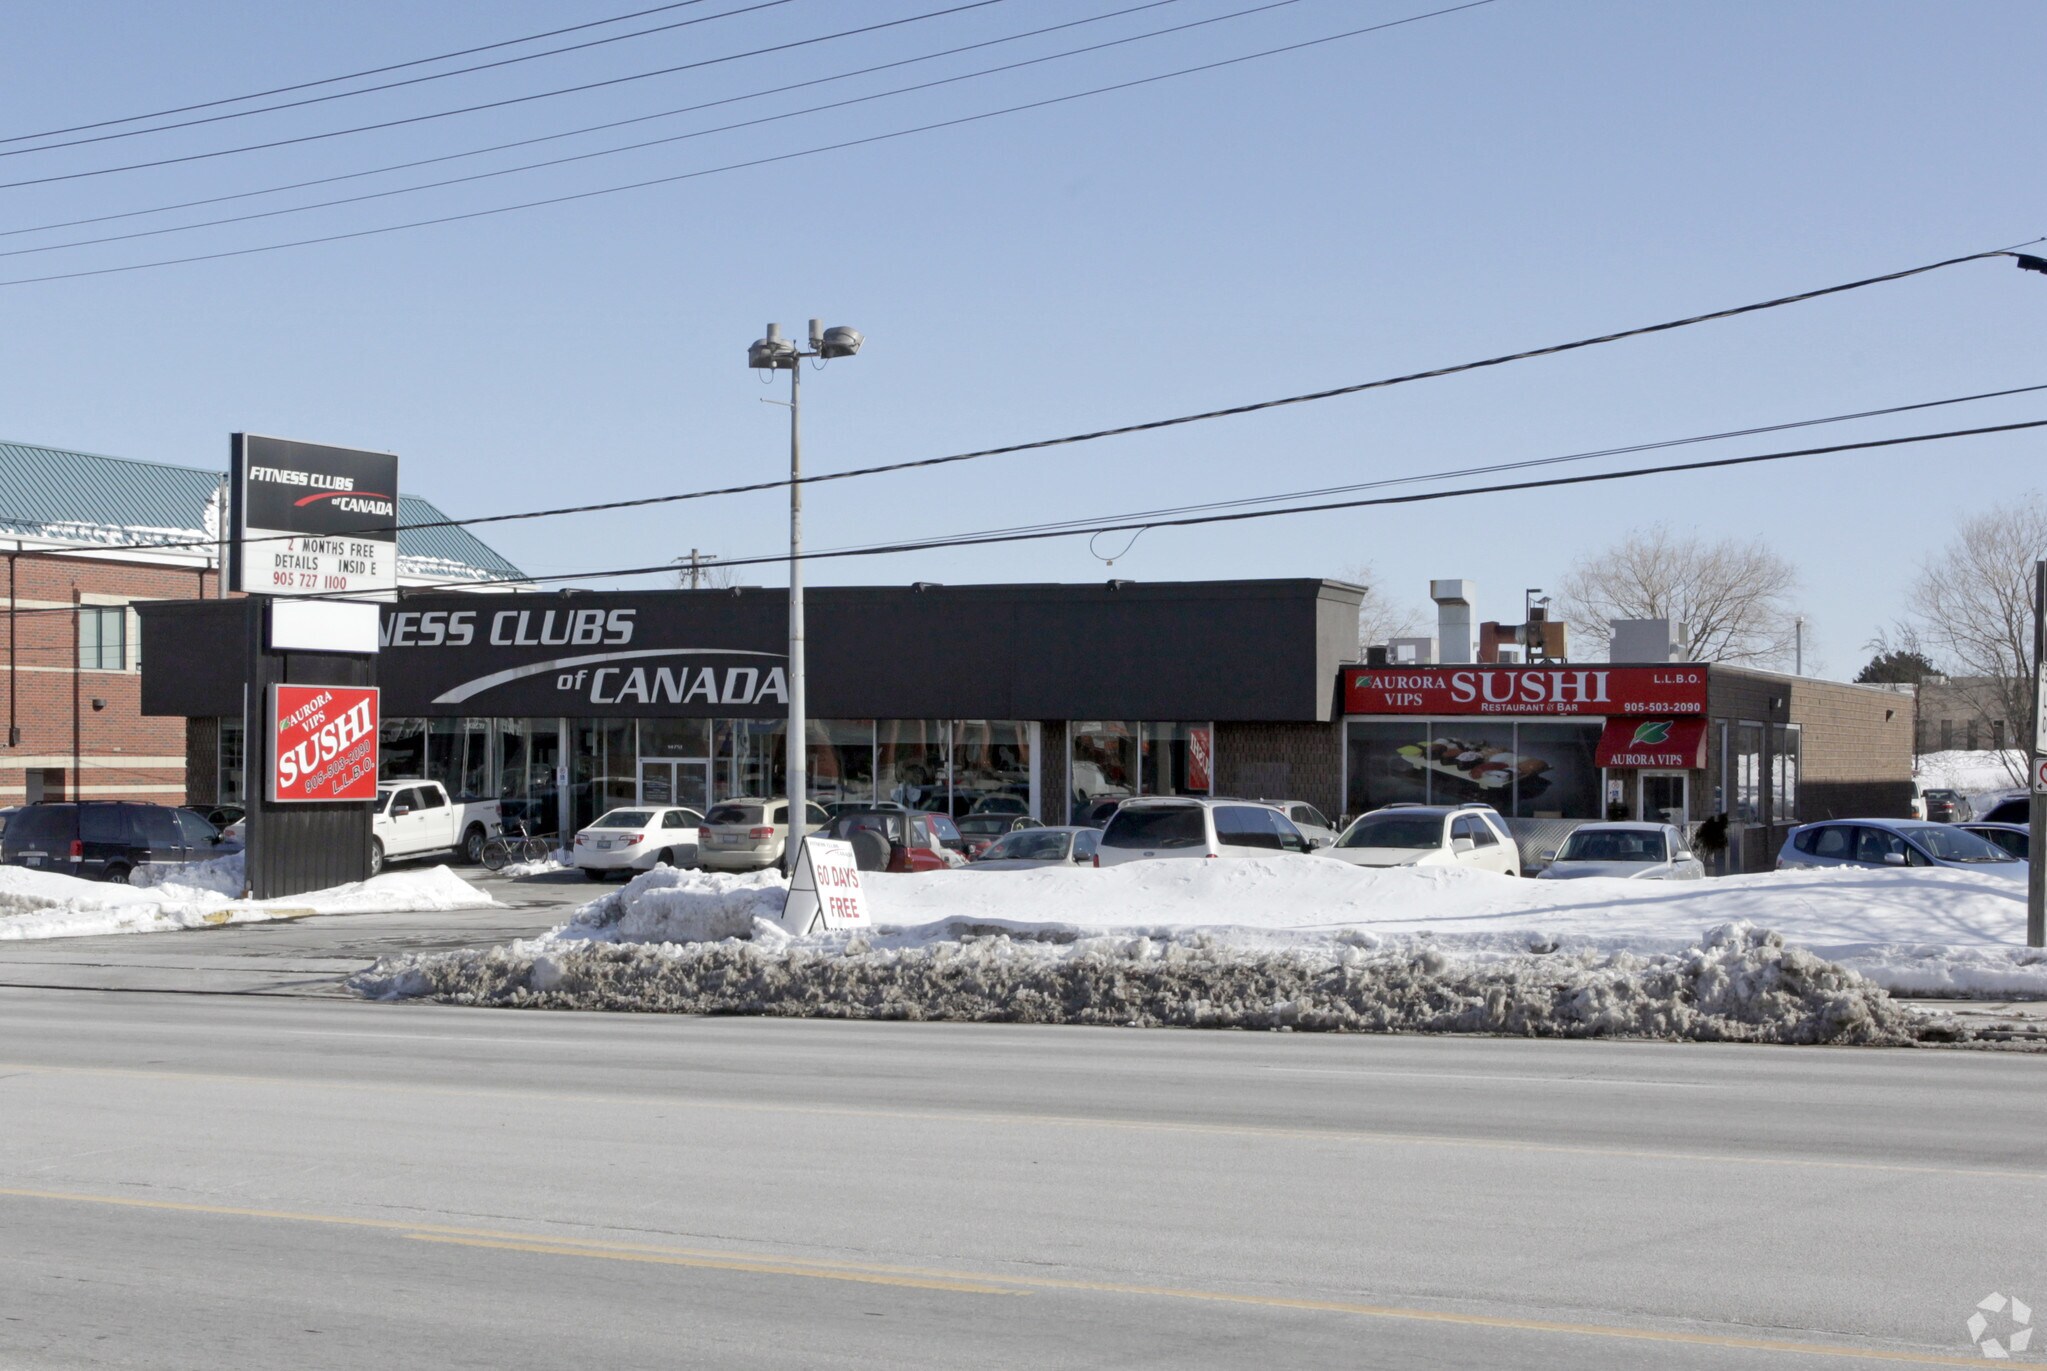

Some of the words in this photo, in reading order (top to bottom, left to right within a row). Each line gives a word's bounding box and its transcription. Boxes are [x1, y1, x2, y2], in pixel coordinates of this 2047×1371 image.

[249, 466, 309, 486] FITNESS
[310, 473, 354, 491] CLUBS
[331, 497, 341, 506] of
[340, 497, 393, 516] CANADA
[288, 538, 294, 551] 2
[302, 539, 345, 556] MONTHS
[350, 543, 375, 558] FREE
[275, 554, 319, 571] DETAILS
[273, 571, 294, 586] 905
[299, 573, 318, 588] 727
[324, 575, 347, 590] 1100
[489, 608, 637, 647] CLUBS
[556, 669, 589, 690] of
[589, 667, 790, 704] CANADA
[1371, 676, 1447, 689] AURORA
[1450, 671, 1611, 703] SUSHI
[1653, 674, 1701, 684] L.L.B.O.
[290, 690, 333, 727] AURORA
[1384, 692, 1423, 706] VIPS
[1624, 702, 1701, 712] 905-503-2090
[302, 710, 326, 732] VIPS
[279, 697, 374, 788] SUSHI
[305, 740, 370, 794] 905-503-2090
[1610, 754, 1656, 765] AURORA
[1657, 754, 1683, 766] VIPS
[332, 758, 375, 795] L.L.B.O.
[816, 864, 830, 886] 60
[831, 866, 859, 888] DAYS
[829, 896, 860, 919] FREE
